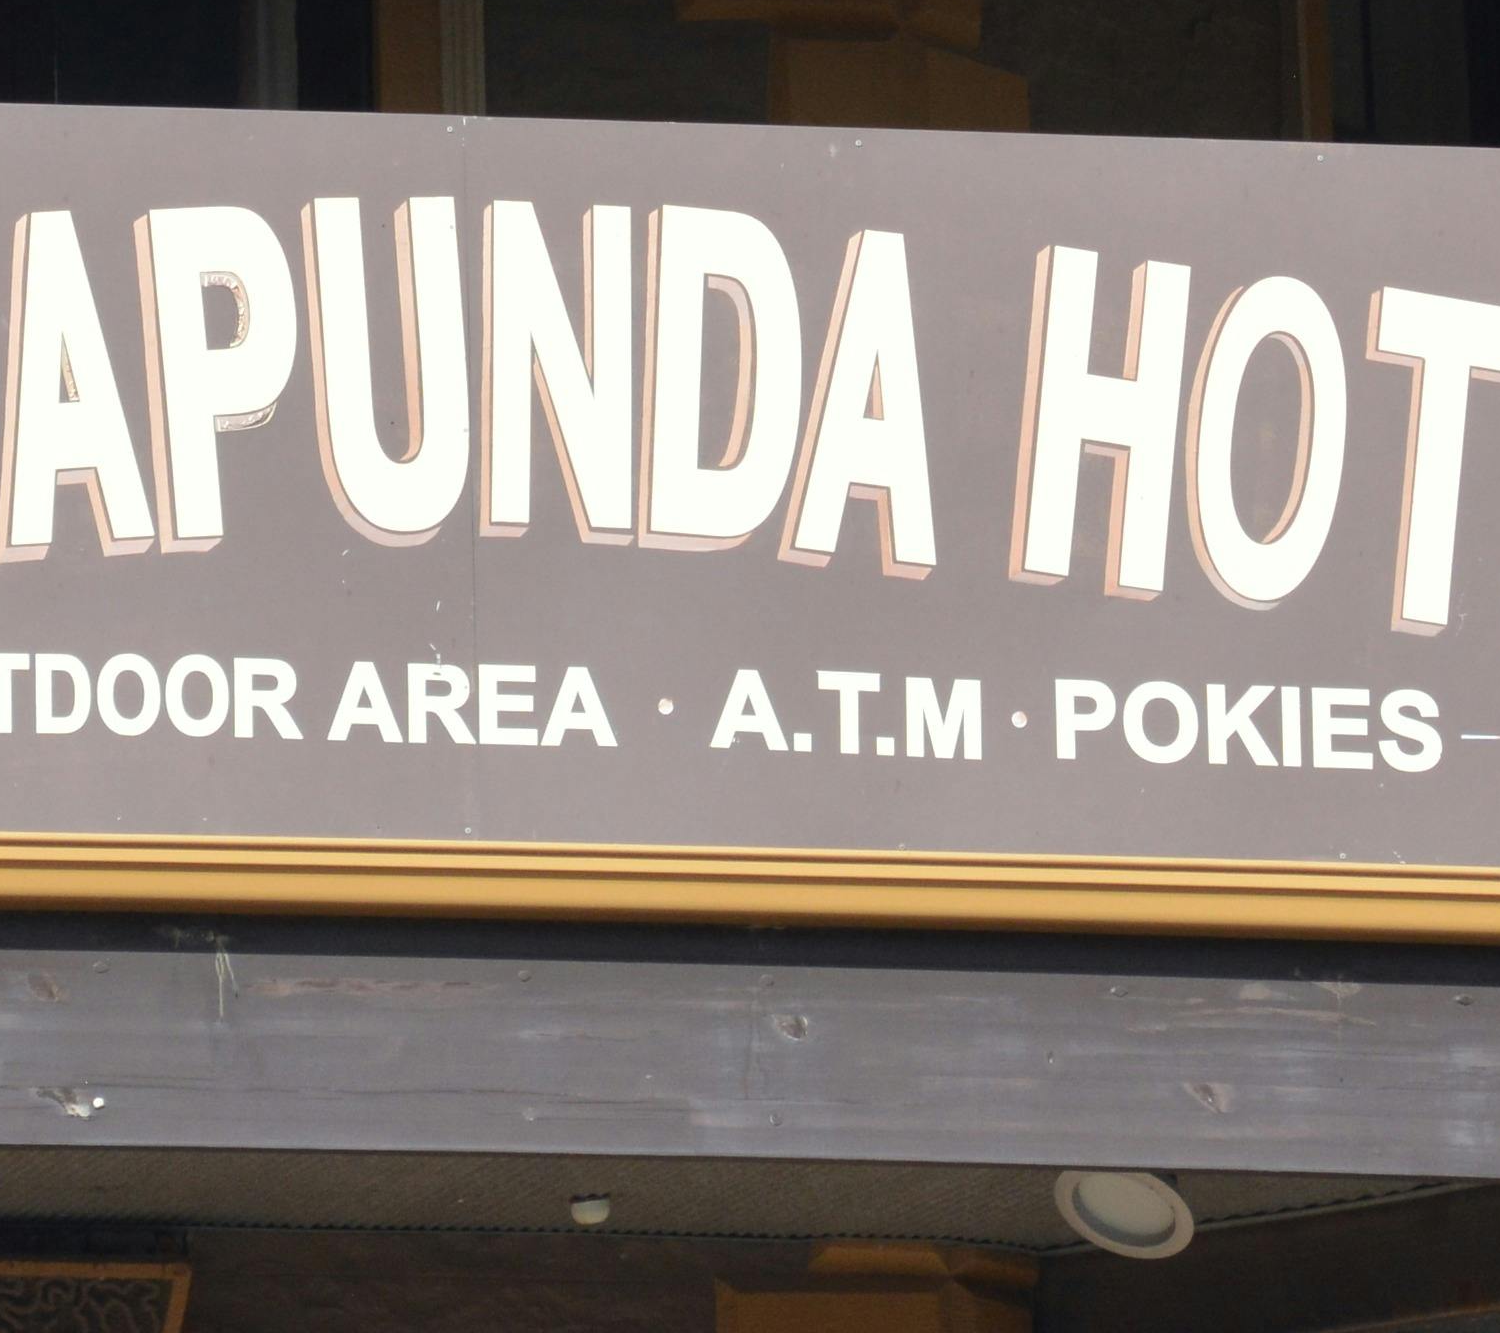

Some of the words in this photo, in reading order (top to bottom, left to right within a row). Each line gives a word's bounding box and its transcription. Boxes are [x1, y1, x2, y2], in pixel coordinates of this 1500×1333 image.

[326, 659, 619, 749] AREA
[709, 667, 984, 761] A.T.M
[1053, 677, 1444, 773] POKIES
